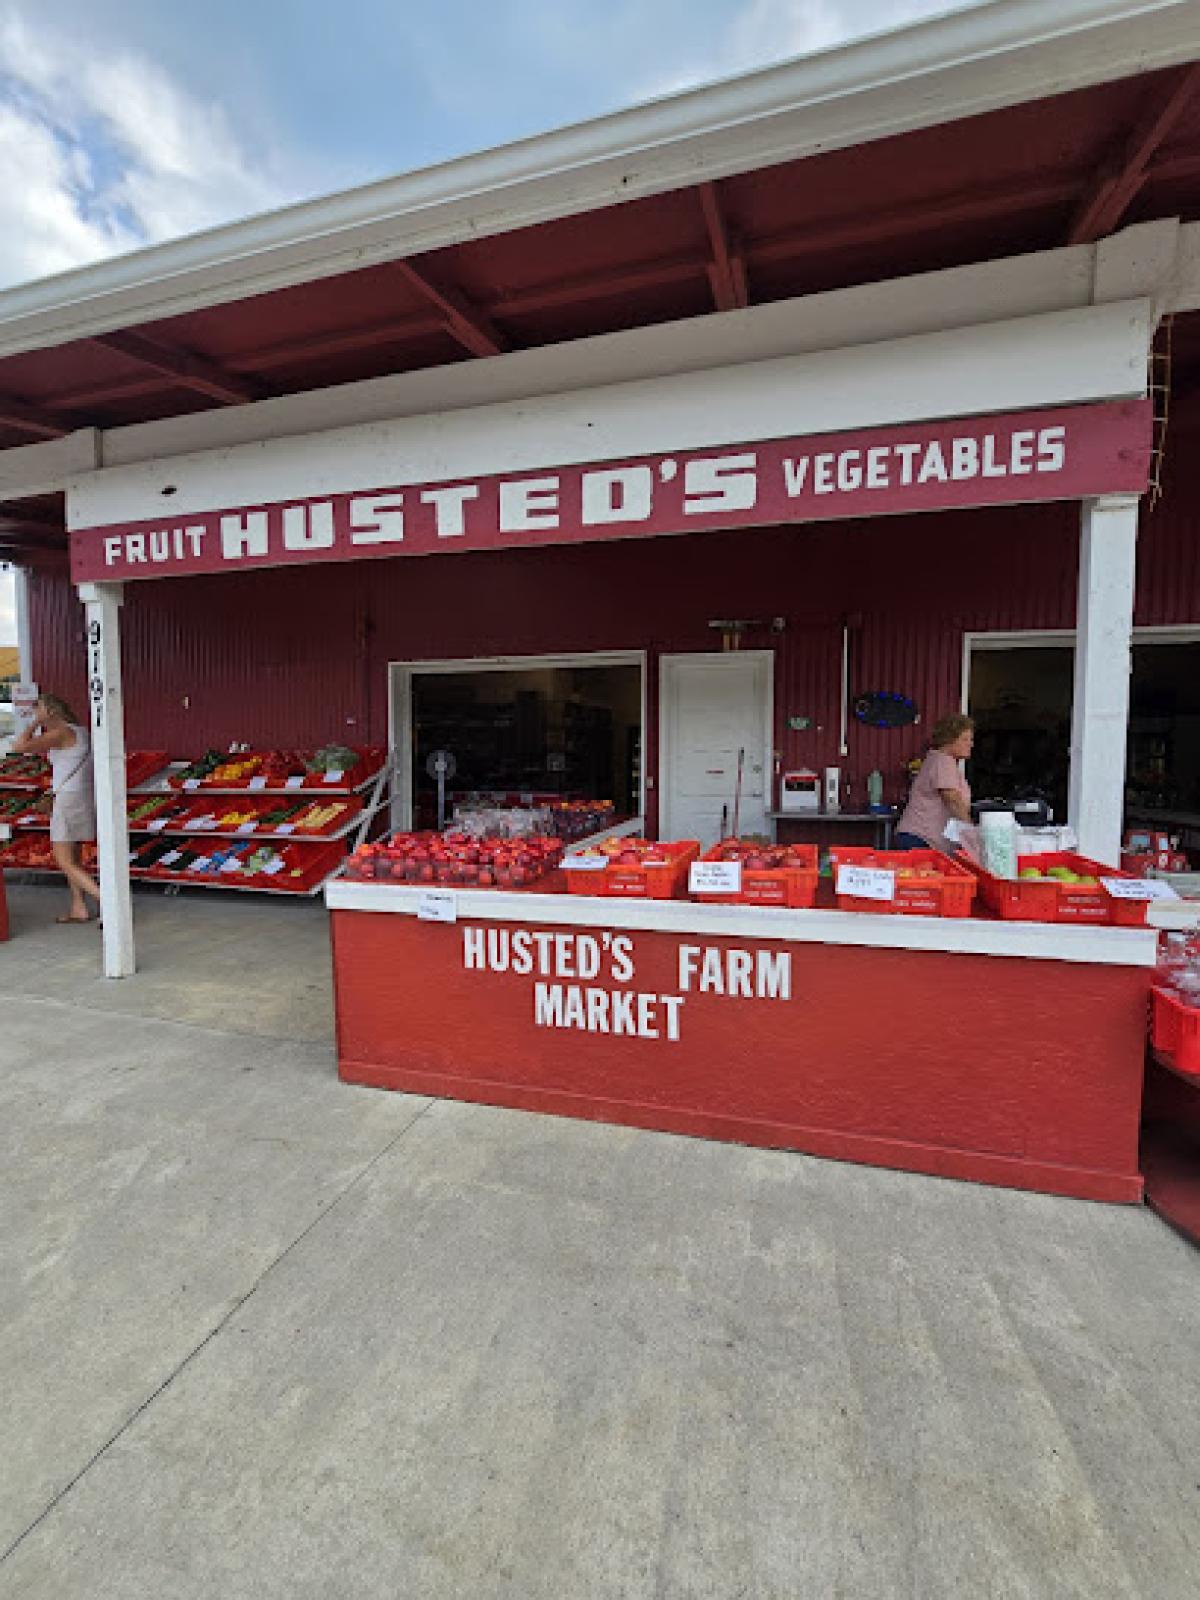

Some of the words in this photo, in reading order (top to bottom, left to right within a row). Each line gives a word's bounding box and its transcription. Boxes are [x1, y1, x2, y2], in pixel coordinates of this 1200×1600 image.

[104, 524, 207, 566] FRUIT
[220, 454, 757, 560] HUSTED'S
[783, 427, 1066, 497] VEGETABLES
[464, 927, 633, 980] HUSTED'S
[679, 945, 791, 1000] FARM
[535, 984, 684, 1041] MARKET
